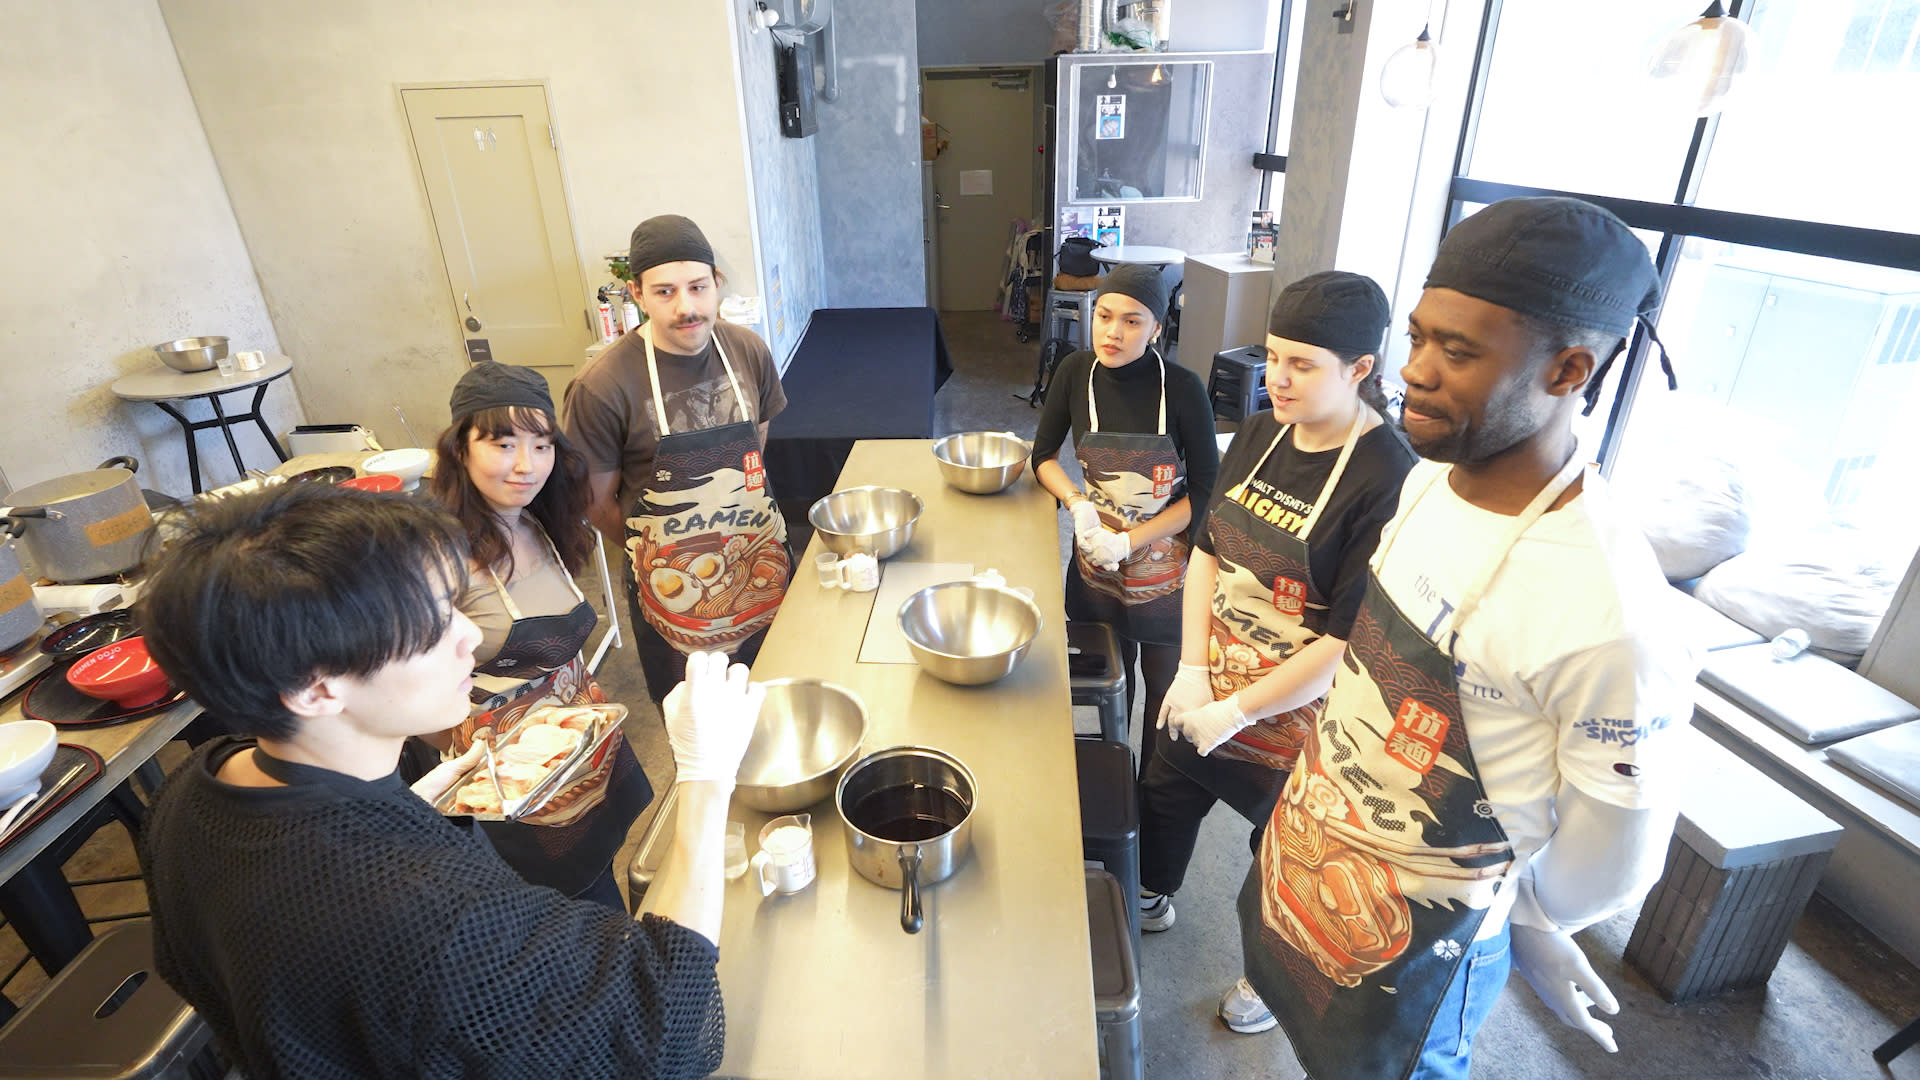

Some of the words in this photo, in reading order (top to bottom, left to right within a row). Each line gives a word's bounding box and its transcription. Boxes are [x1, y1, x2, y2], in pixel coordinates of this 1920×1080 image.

[663, 508, 772, 537] RAMEN
[1213, 581, 1297, 659] AMEN
[97, 646, 121, 661] DOJO
[1573, 717, 1600, 729] ALL
[1602, 717, 1634, 729] THE
